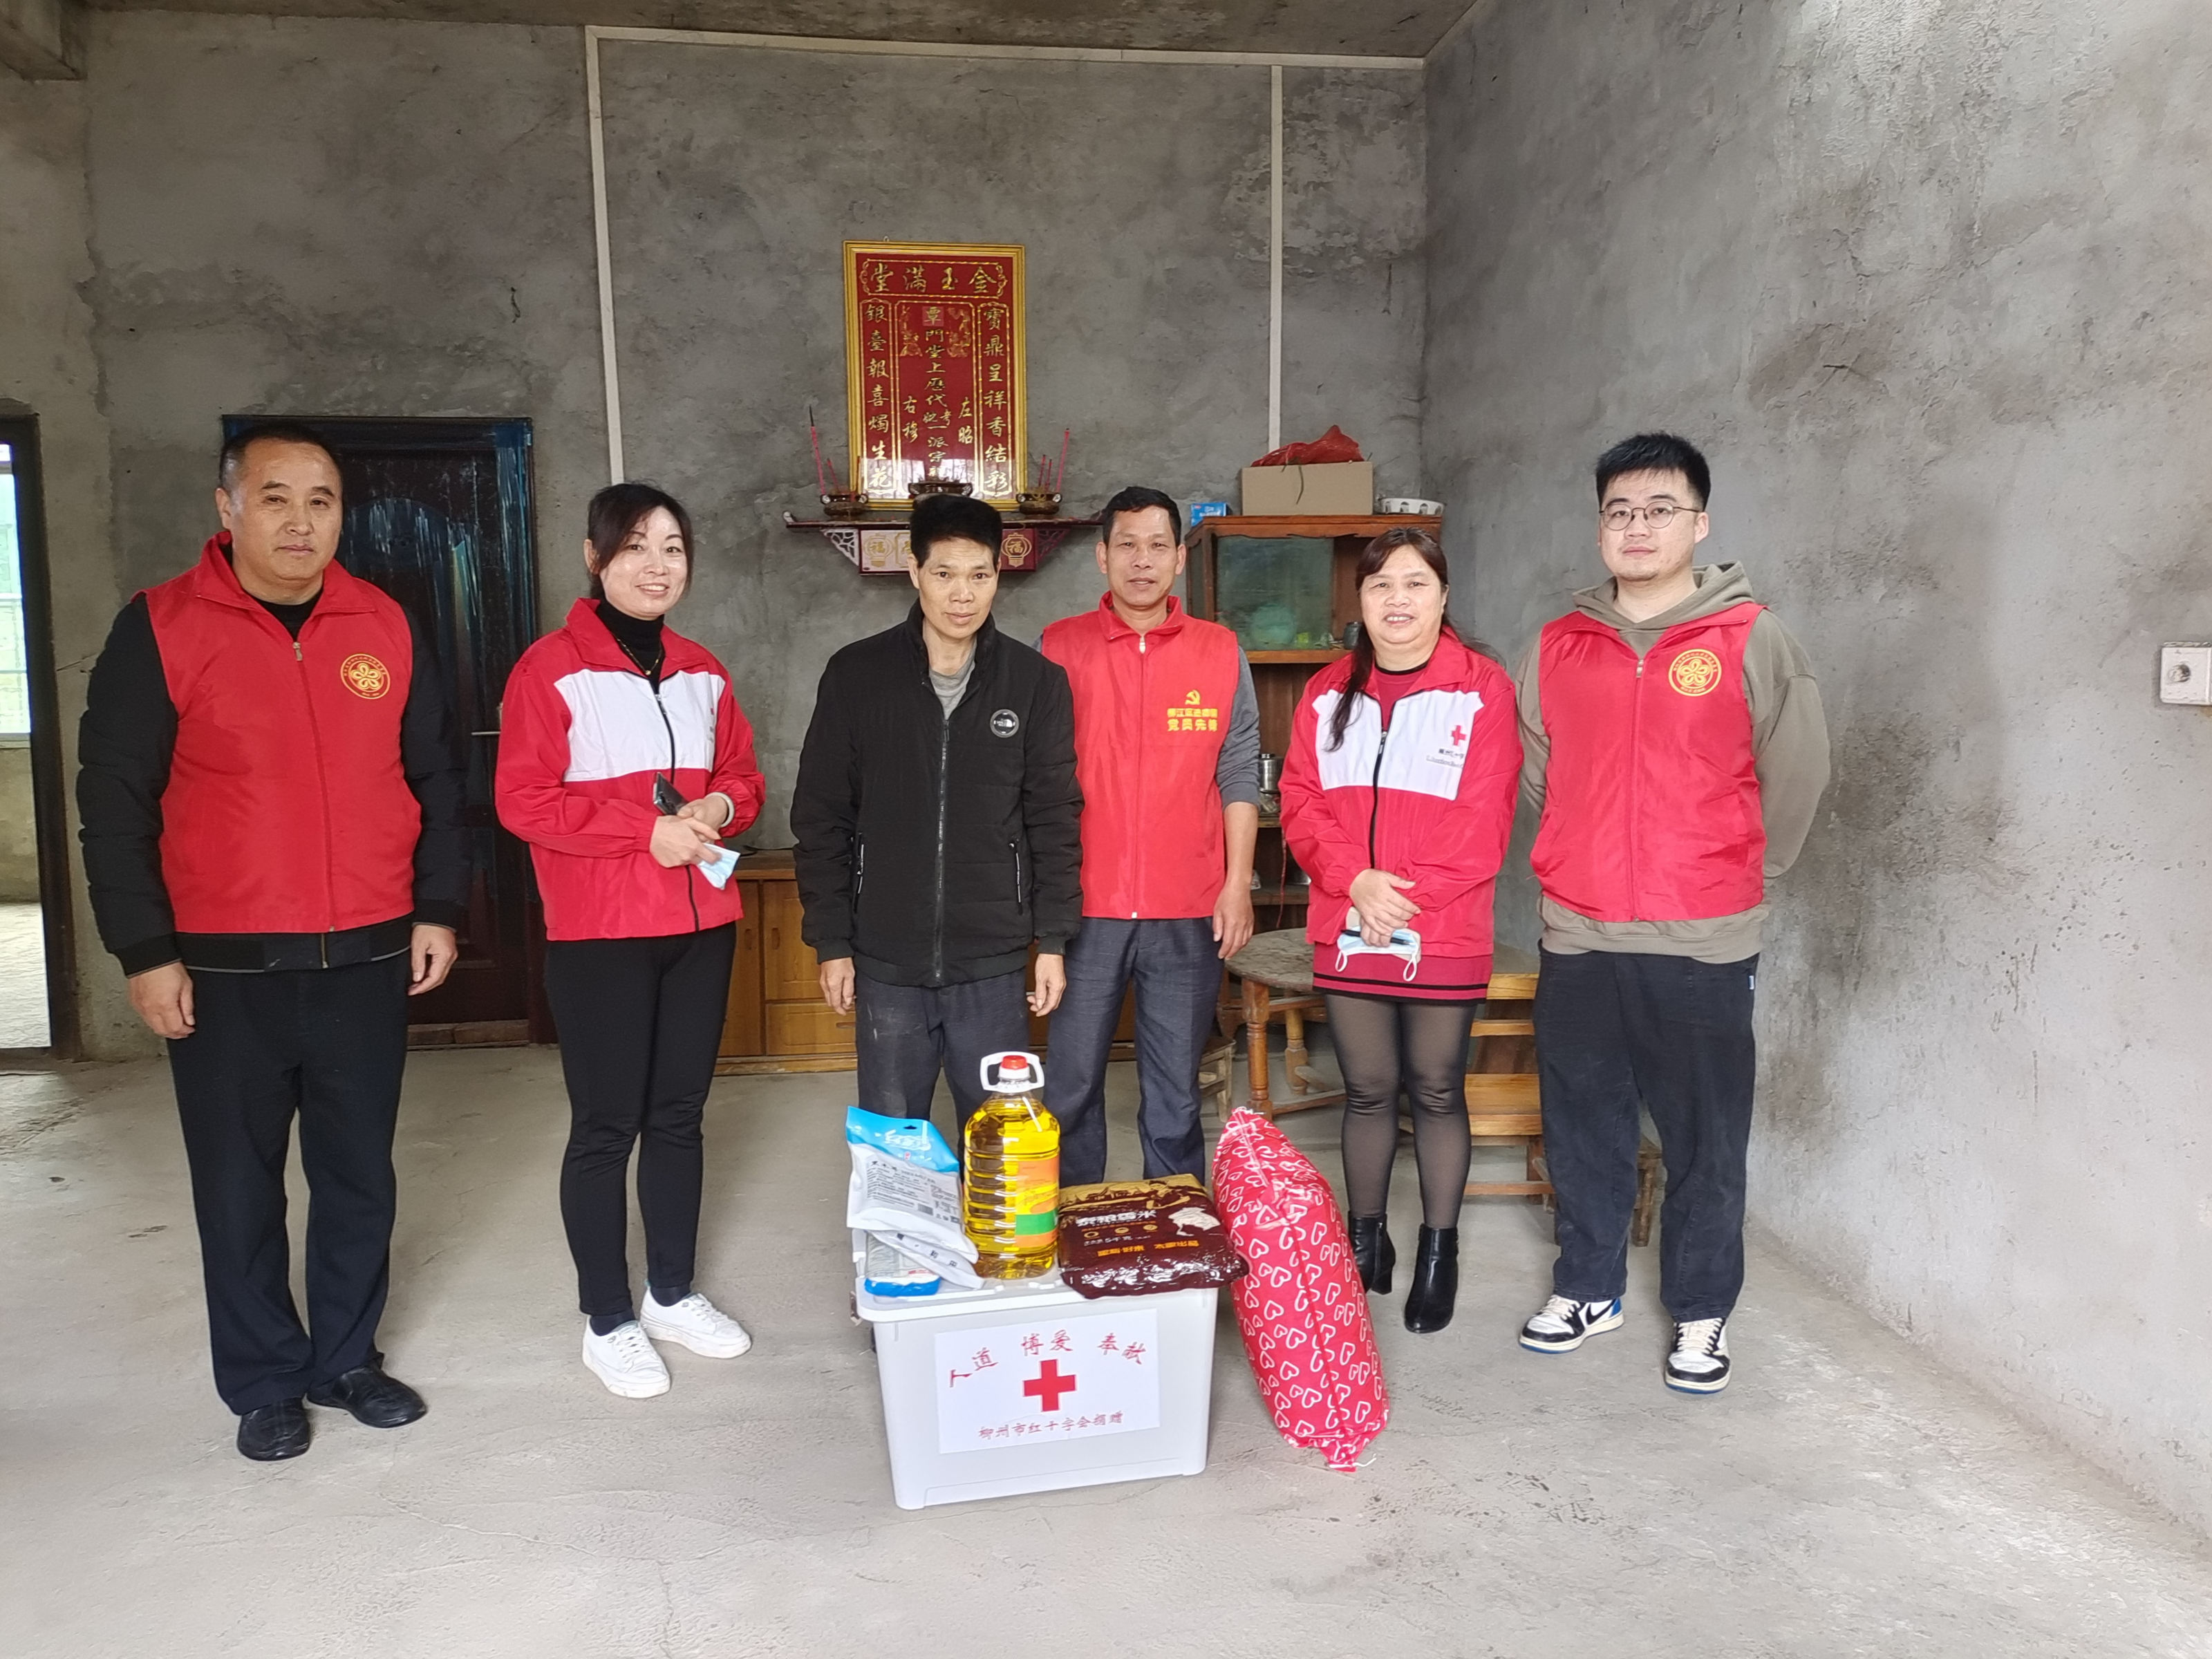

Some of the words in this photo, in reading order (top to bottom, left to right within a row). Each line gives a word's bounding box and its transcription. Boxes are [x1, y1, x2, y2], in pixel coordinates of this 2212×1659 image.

[1007, 541, 1024, 554] 福
[949, 1346, 1000, 1388] 人道
[1020, 1329, 1074, 1357] 博爱
[1096, 1332, 1149, 1365] 奉献
[977, 1410, 1124, 1441] 柳州市红十字会捐赠
